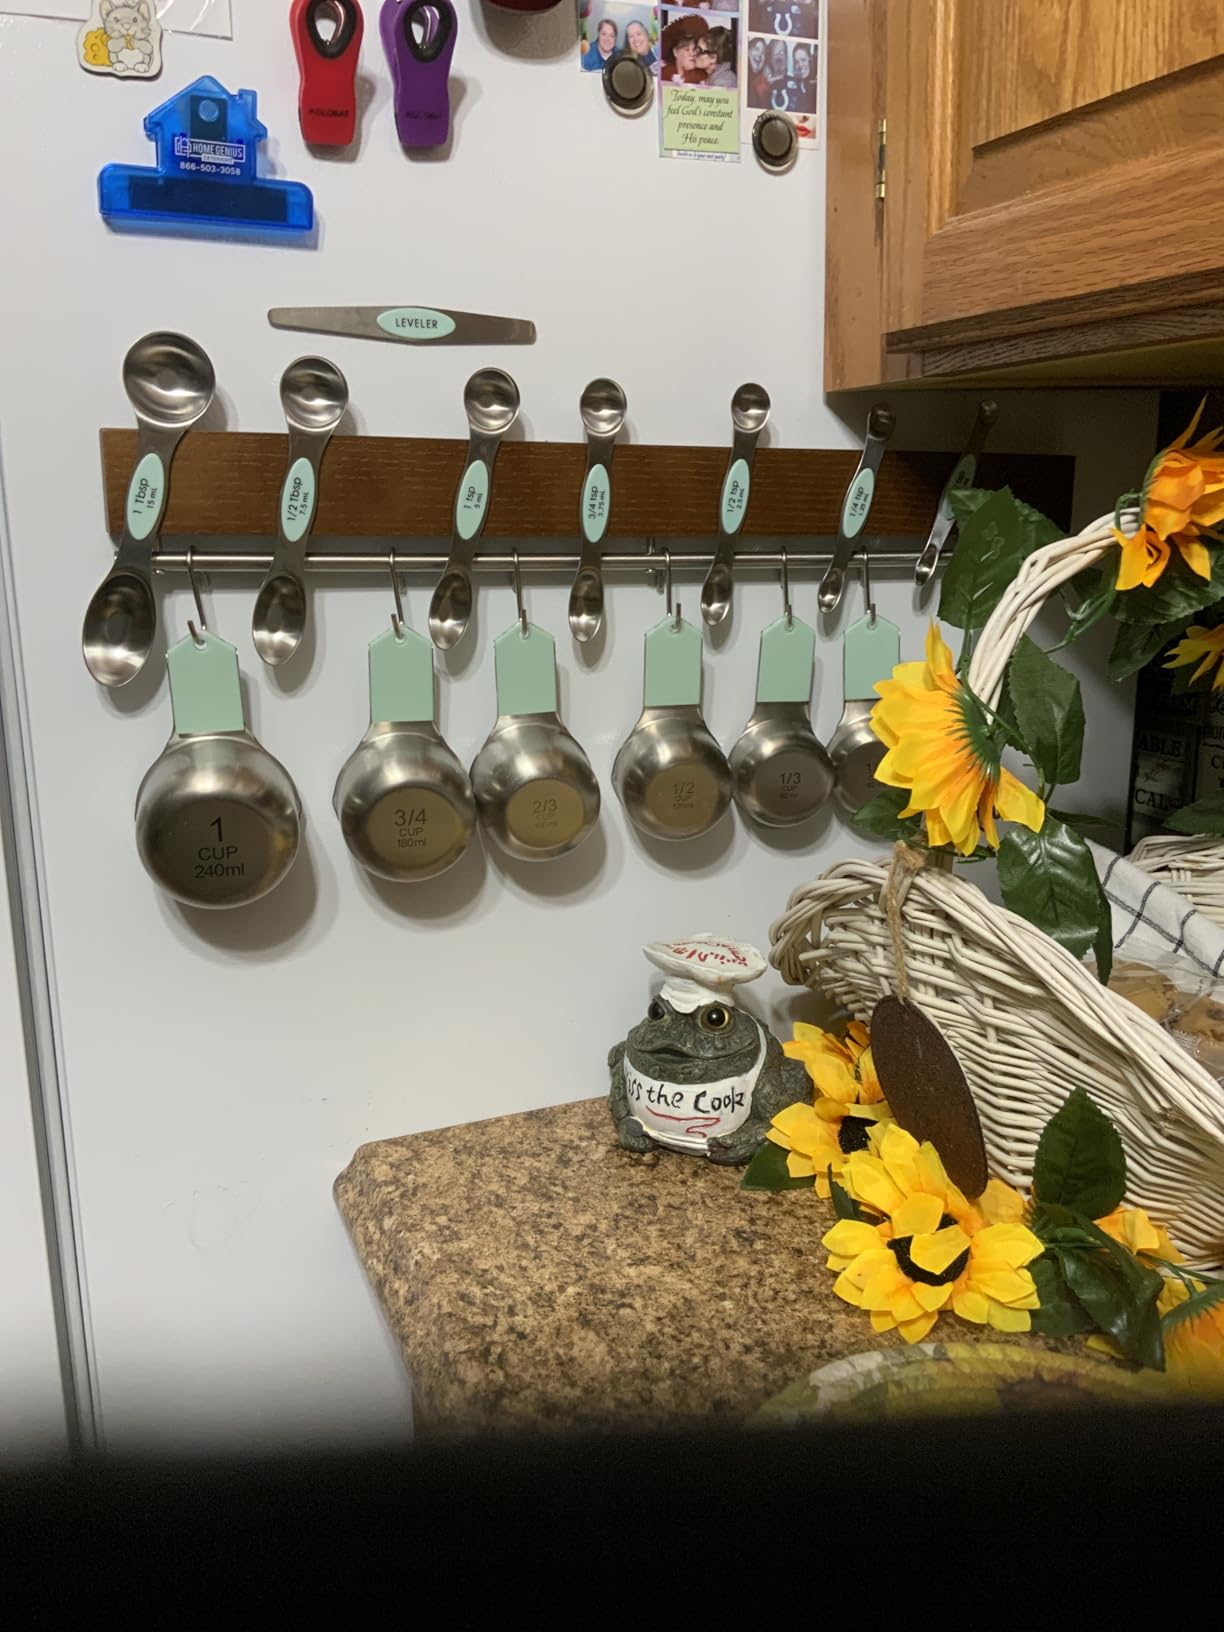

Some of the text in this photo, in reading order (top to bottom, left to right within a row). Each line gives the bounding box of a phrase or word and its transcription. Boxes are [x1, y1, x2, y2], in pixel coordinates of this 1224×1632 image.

[699, 96, 714, 108] may
[714, 97, 730, 108] you
[665, 104, 734, 119] feel God's constant
[676, 120, 726, 133] presence and
[681, 132, 698, 145] His
[193, 143, 243, 158] HOME GENIUS
[180, 162, 241, 175] 866-503-3058
[395, 317, 438, 329] LEVELER
[135, 478, 150, 504] Tbsp
[465, 486, 477, 502] tsp
[727, 480, 740, 513] 1/2 tsp
[287, 477, 303, 521] 1/2 Tbsp
[588, 486, 599, 520] 3/4 tsp
[849, 502, 859, 517] 1/4
[780, 772, 801, 785] 1/3
[672, 782, 696, 795] 1/2
[533, 798, 558, 814] 2/3
[394, 808, 428, 827] 3/4
[210, 816, 223, 842] 1
[399, 827, 424, 837] CUP
[198, 845, 239, 861] CUP
[194, 863, 245, 879] 240ml
[646, 1083, 684, 1109] the
[694, 1085, 745, 1114] Cook
